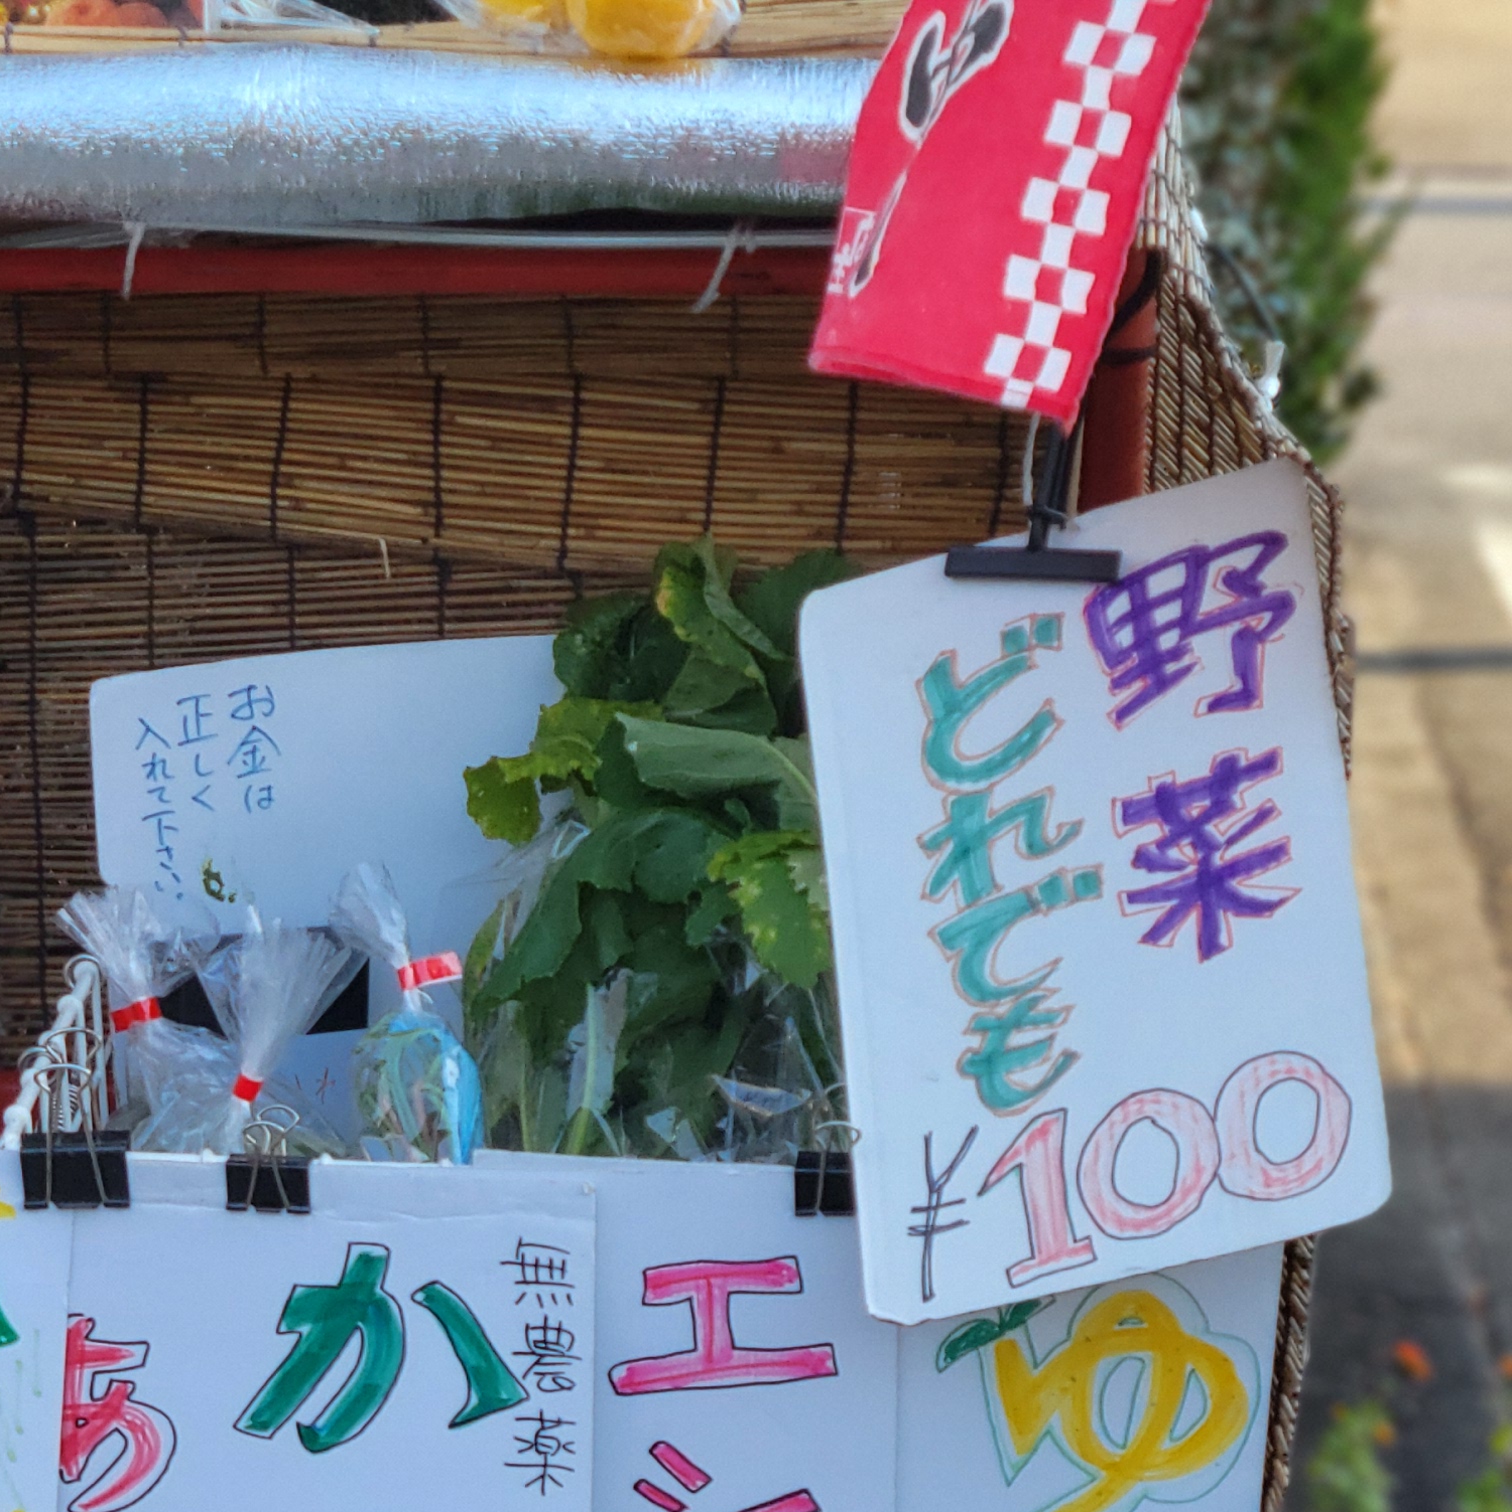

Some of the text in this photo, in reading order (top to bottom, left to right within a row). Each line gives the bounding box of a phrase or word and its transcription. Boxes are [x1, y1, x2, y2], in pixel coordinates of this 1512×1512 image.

[176, 692, 218, 812] 正しく
[227, 684, 282, 814] お金は
[917, 612, 1105, 1118] どれでも
[1084, 529, 1302, 963] 野菜
[908, 1050, 1352, 1302] ¥100
[500, 1237, 581, 1496] 無農薬
